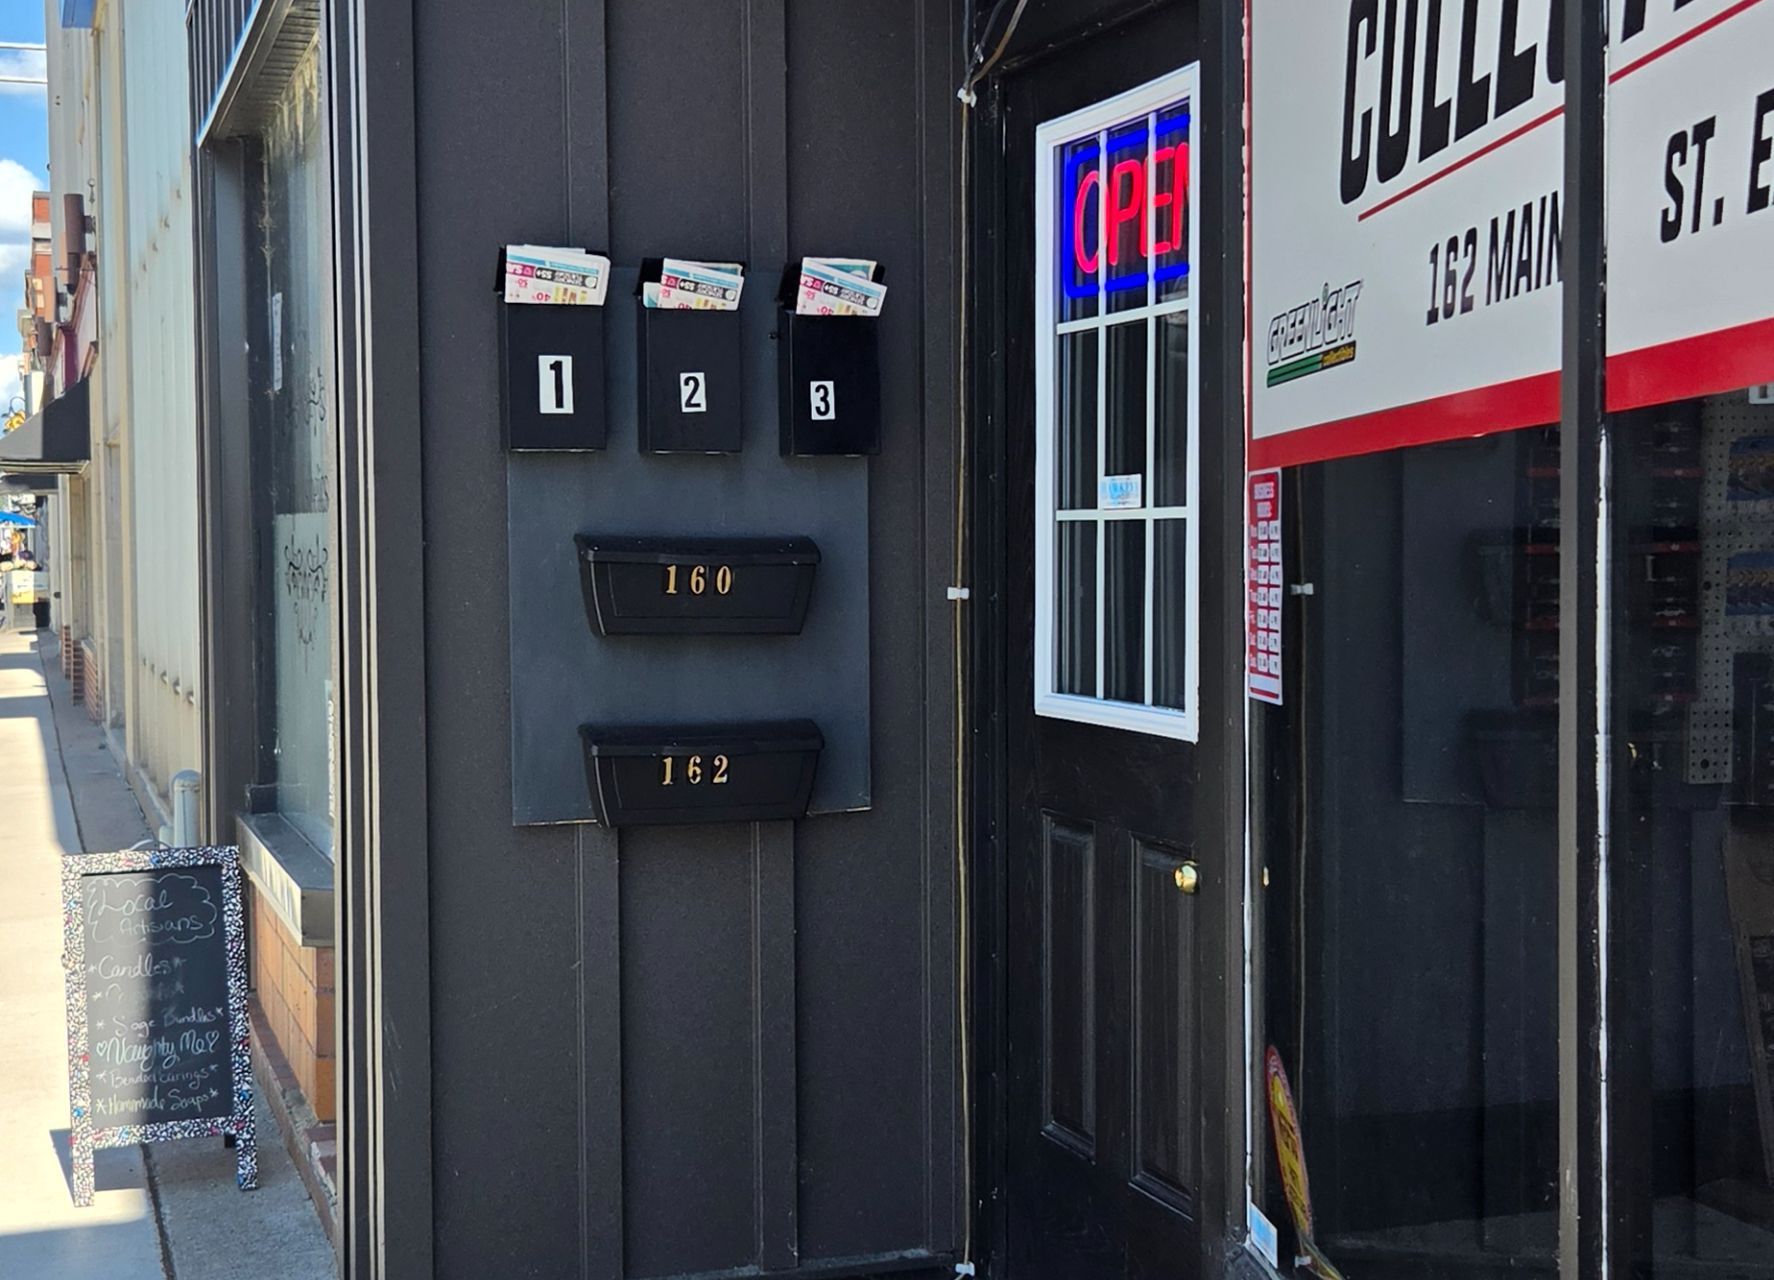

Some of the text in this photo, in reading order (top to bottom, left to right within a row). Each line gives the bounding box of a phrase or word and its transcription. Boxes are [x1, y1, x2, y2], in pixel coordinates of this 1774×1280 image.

[1426, 87, 1774, 325] 162 MAIN ST. E
[549, 360, 564, 409] 1
[683, 376, 701, 408] 2
[815, 384, 831, 417] 3
[665, 564, 732, 595] 160
[661, 754, 729, 785] 162
[98, 889, 173, 916] Local
[98, 952, 171, 979] Candles
[113, 1006, 216, 1038] Sage Bundles
[106, 1029, 207, 1072] Naughty Me
[168, 1088, 209, 1112] Soaps
